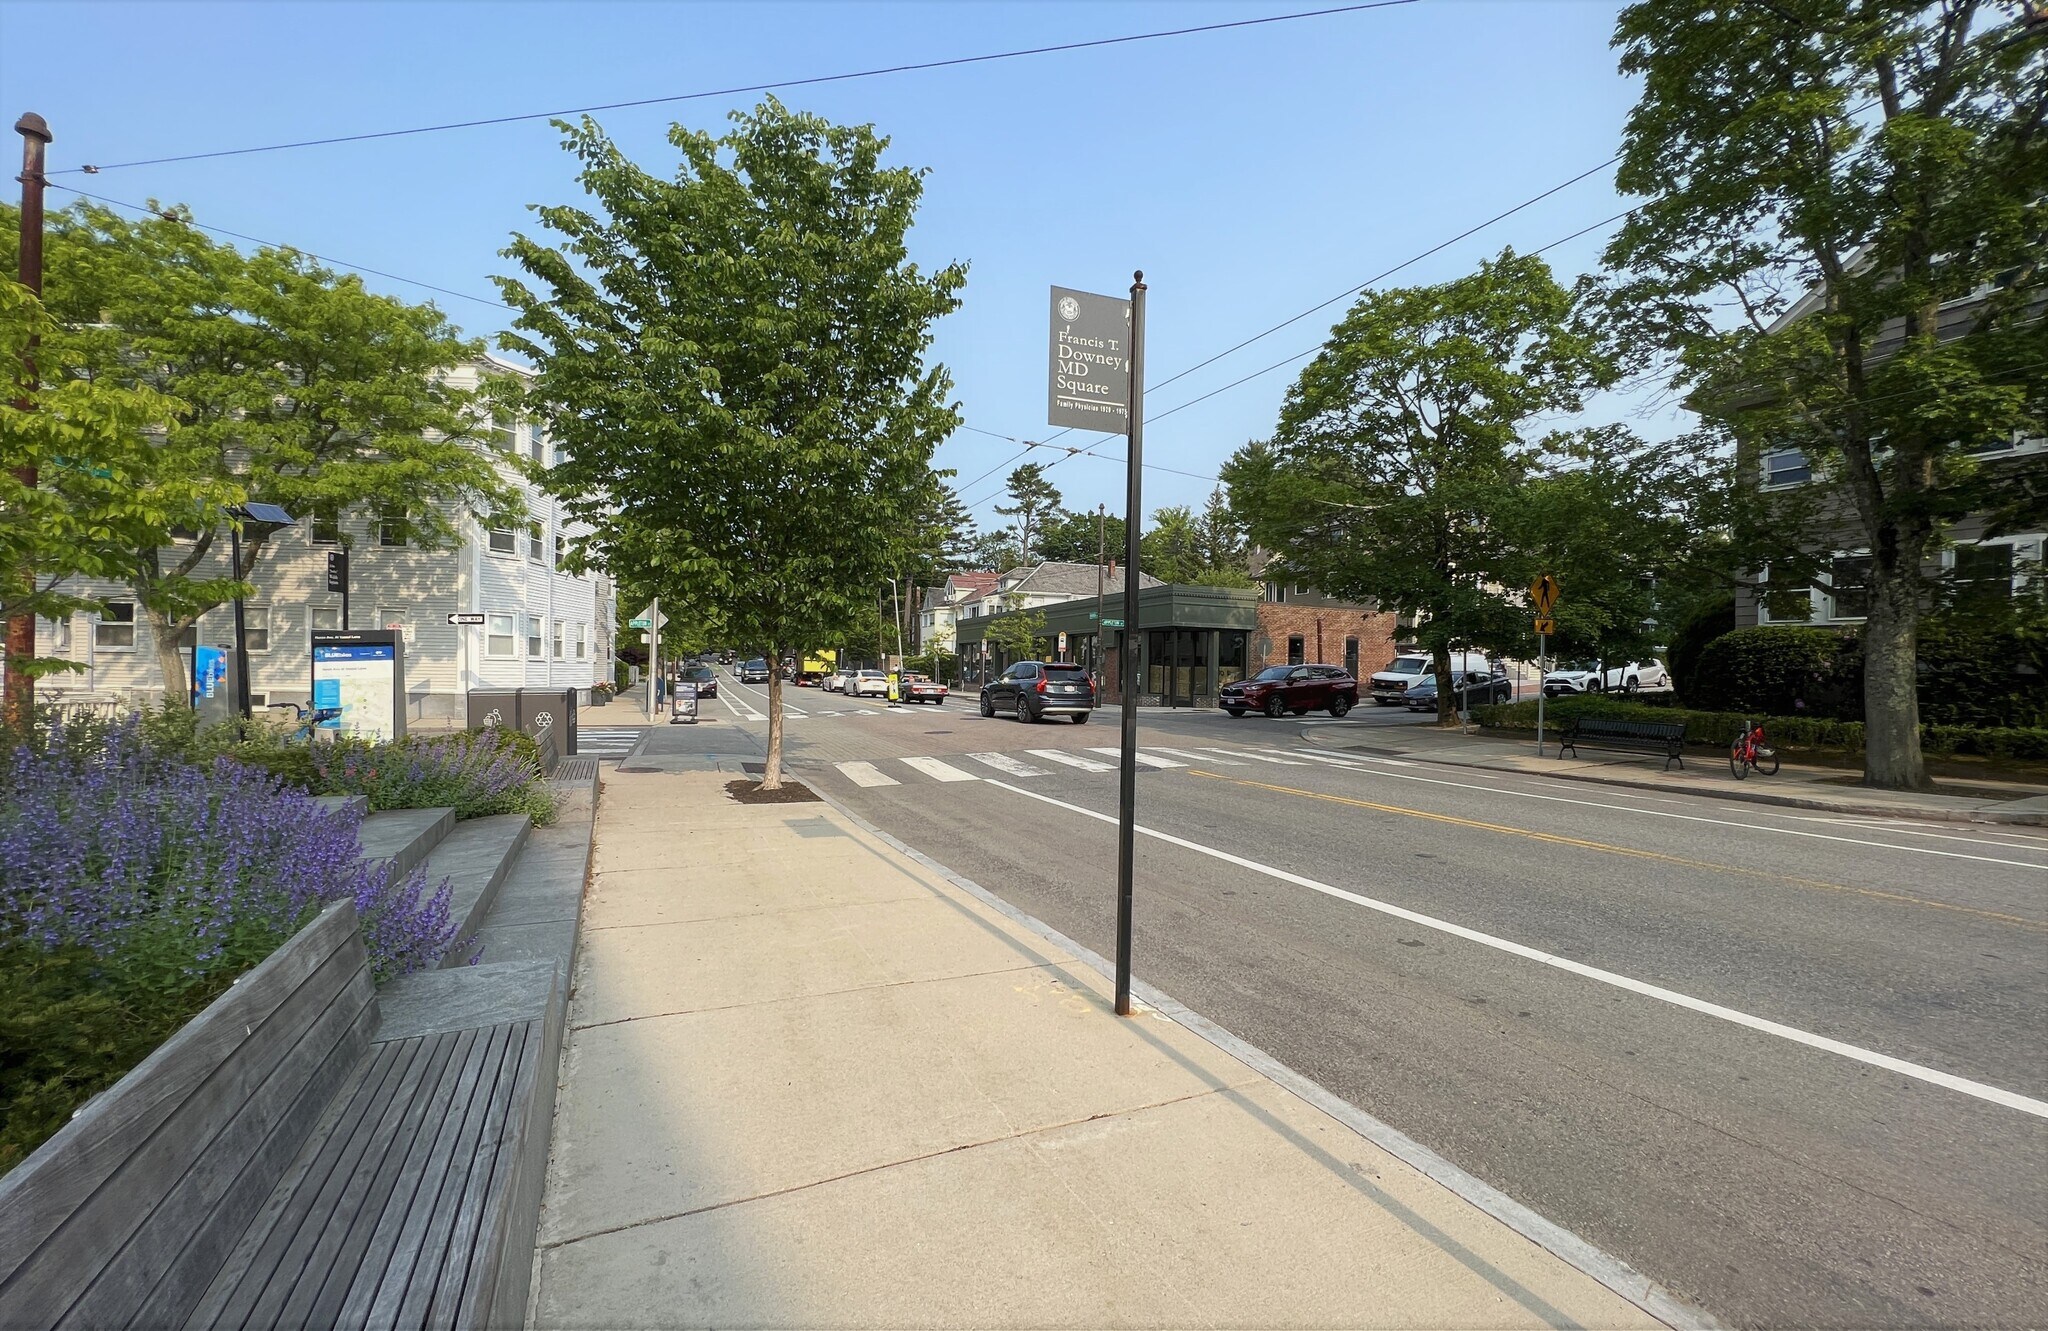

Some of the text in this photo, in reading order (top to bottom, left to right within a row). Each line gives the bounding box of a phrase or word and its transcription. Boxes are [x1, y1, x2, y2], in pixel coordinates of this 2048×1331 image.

[1058, 331, 1119, 351] Francis T.
[1058, 344, 1122, 370] Downey
[1057, 360, 1089, 377] MD
[1057, 375, 1109, 395] Square
[1056, 400, 1073, 410] Family
[1074, 401, 1099, 412] Physician
[206, 659, 215, 698] BLUEbikes
